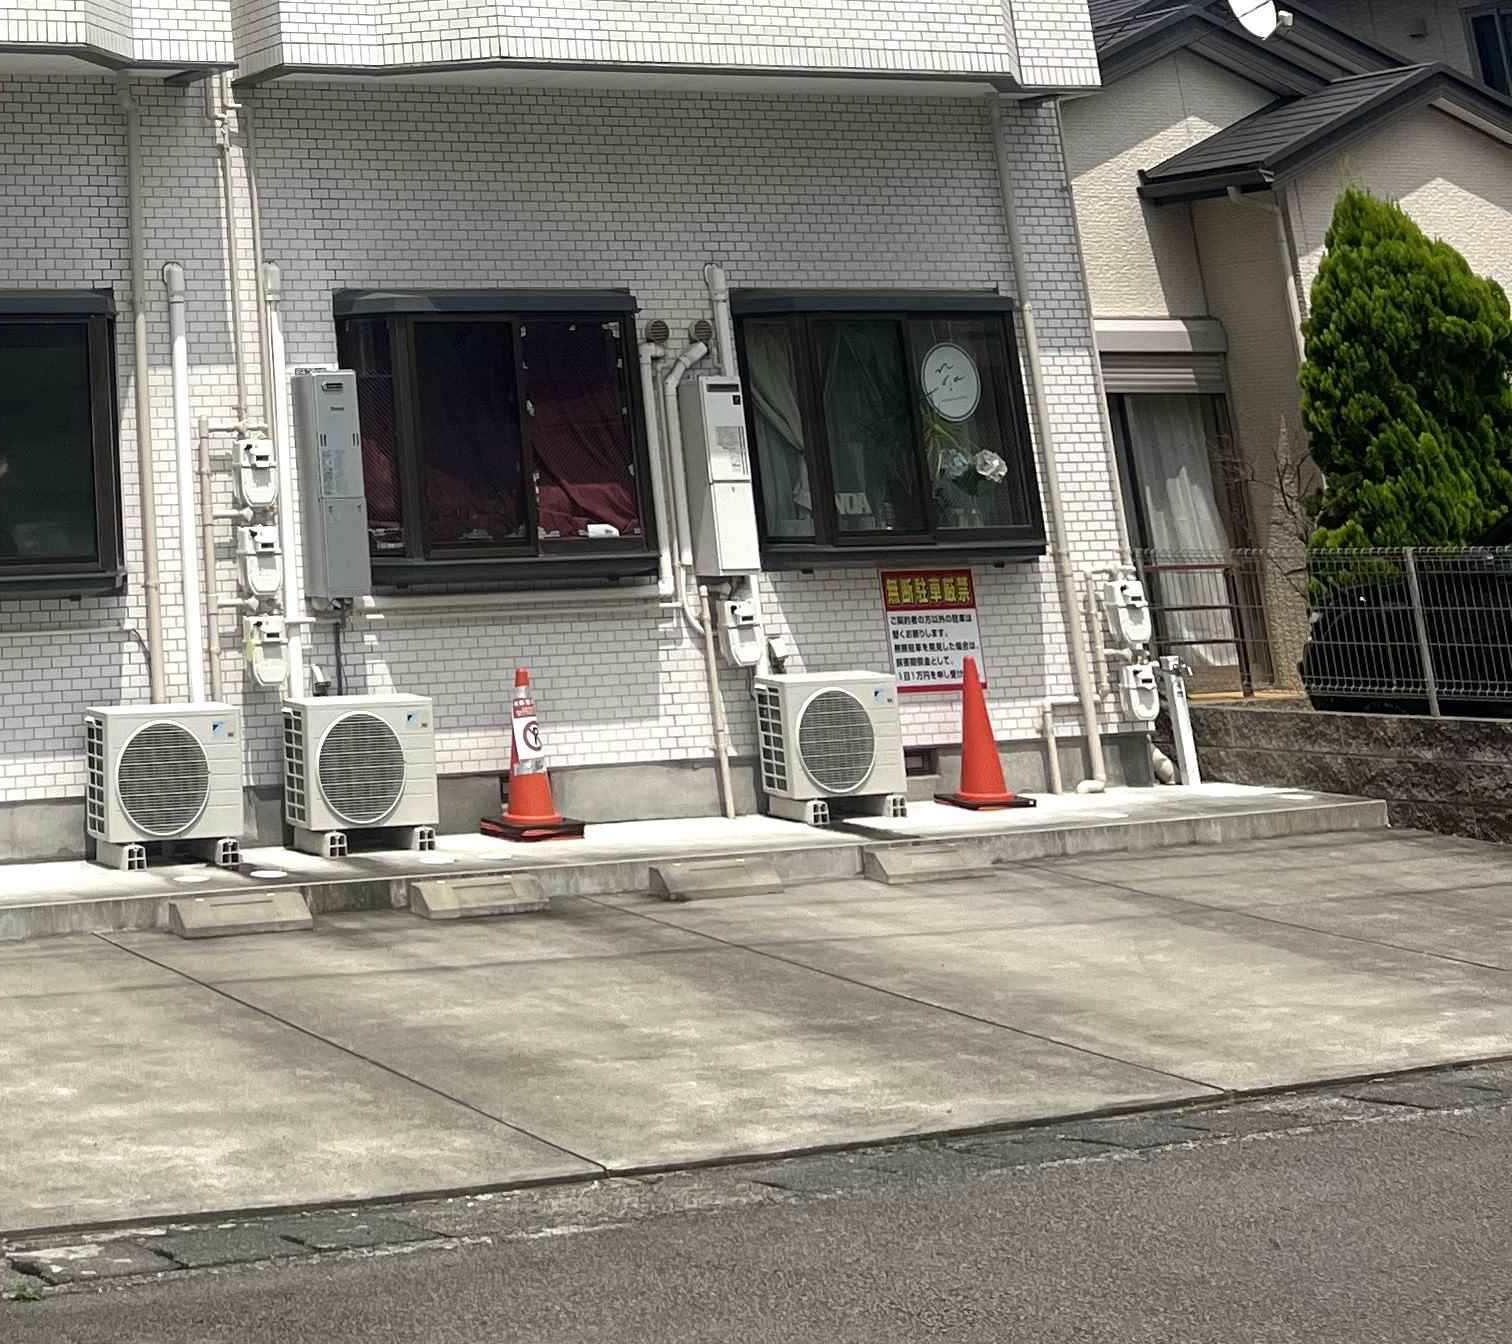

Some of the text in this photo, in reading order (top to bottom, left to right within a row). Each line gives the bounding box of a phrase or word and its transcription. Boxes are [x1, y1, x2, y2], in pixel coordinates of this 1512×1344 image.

[886, 576, 970, 604] 無断駐車厳禁
